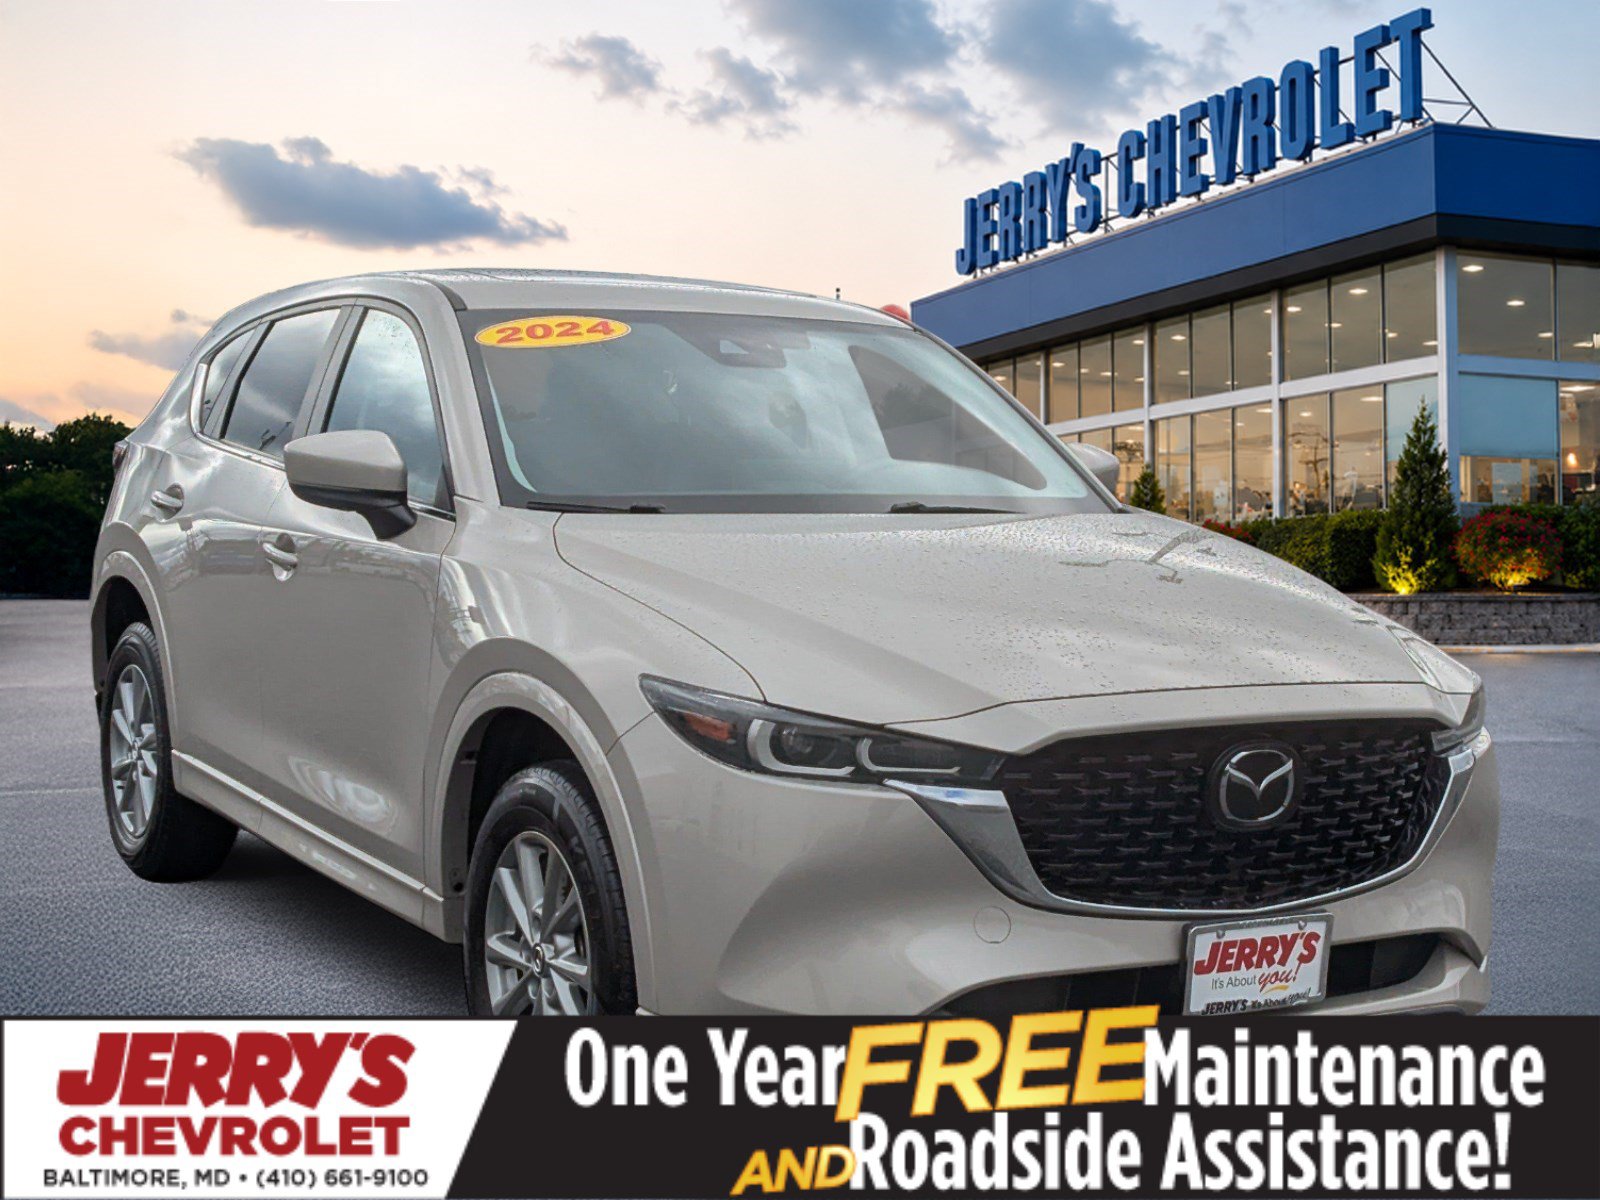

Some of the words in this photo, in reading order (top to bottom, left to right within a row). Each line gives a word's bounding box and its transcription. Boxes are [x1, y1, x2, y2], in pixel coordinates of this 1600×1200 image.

[956, 142, 1101, 276] JERRY'S
[1117, 7, 1434, 219] CHEVROLET
[496, 320, 615, 344] 2024
[1194, 931, 1321, 976] JERRY'S
[1211, 977, 1225, 990] It's
[1226, 975, 1257, 988] About
[1258, 962, 1300, 993] you!
[1201, 999, 1248, 1016] JERRY'S
